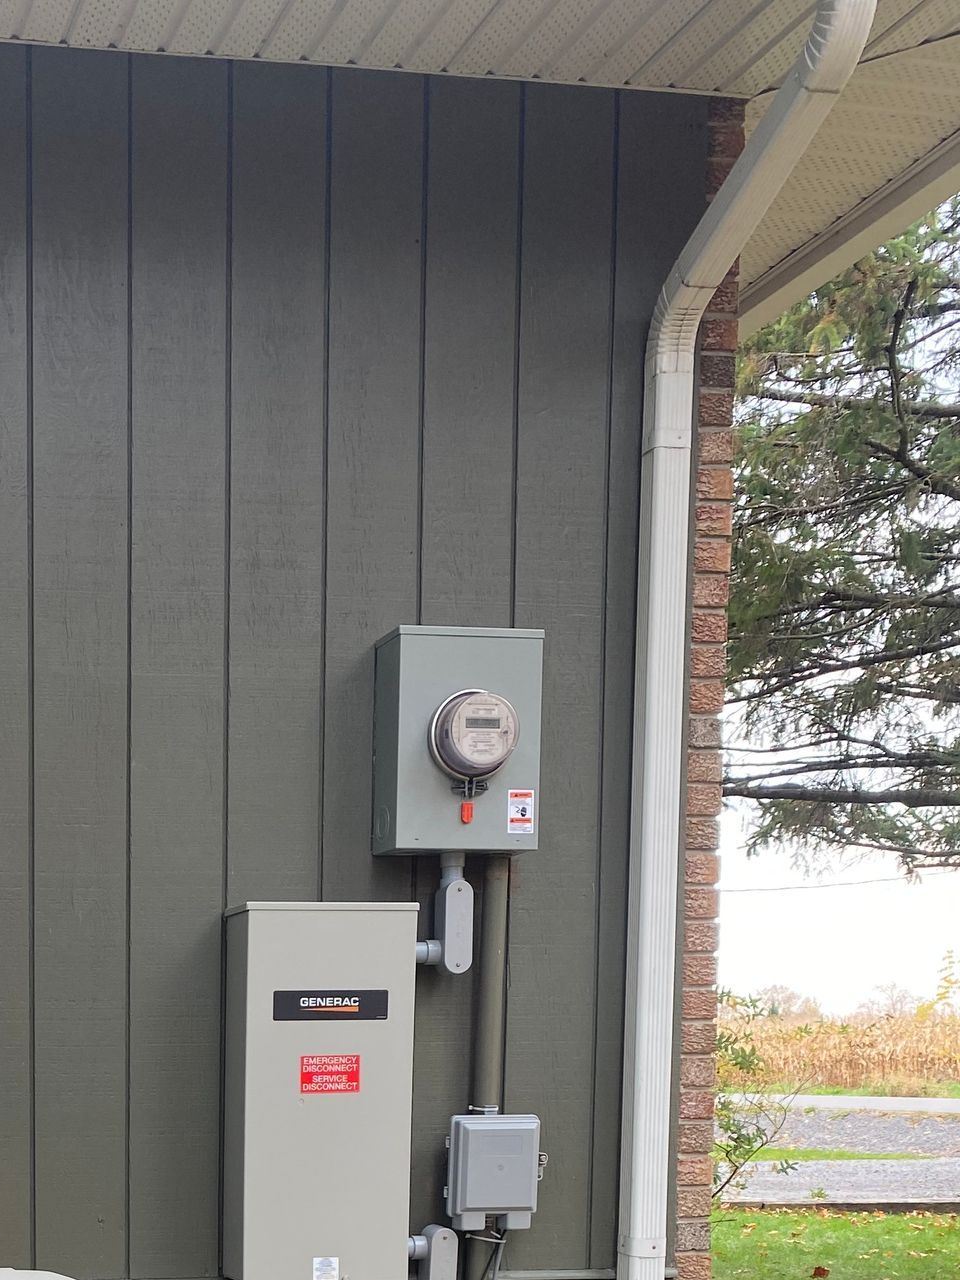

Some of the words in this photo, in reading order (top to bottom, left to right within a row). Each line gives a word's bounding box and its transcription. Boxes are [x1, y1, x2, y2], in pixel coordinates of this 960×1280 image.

[299, 997, 359, 1007] GENERAC
[303, 1056, 357, 1065] EMERGENCY
[302, 1064, 358, 1073] DISCONNECT
[312, 1074, 349, 1083] SERVICE
[302, 1082, 358, 1091] DISCONNECT
